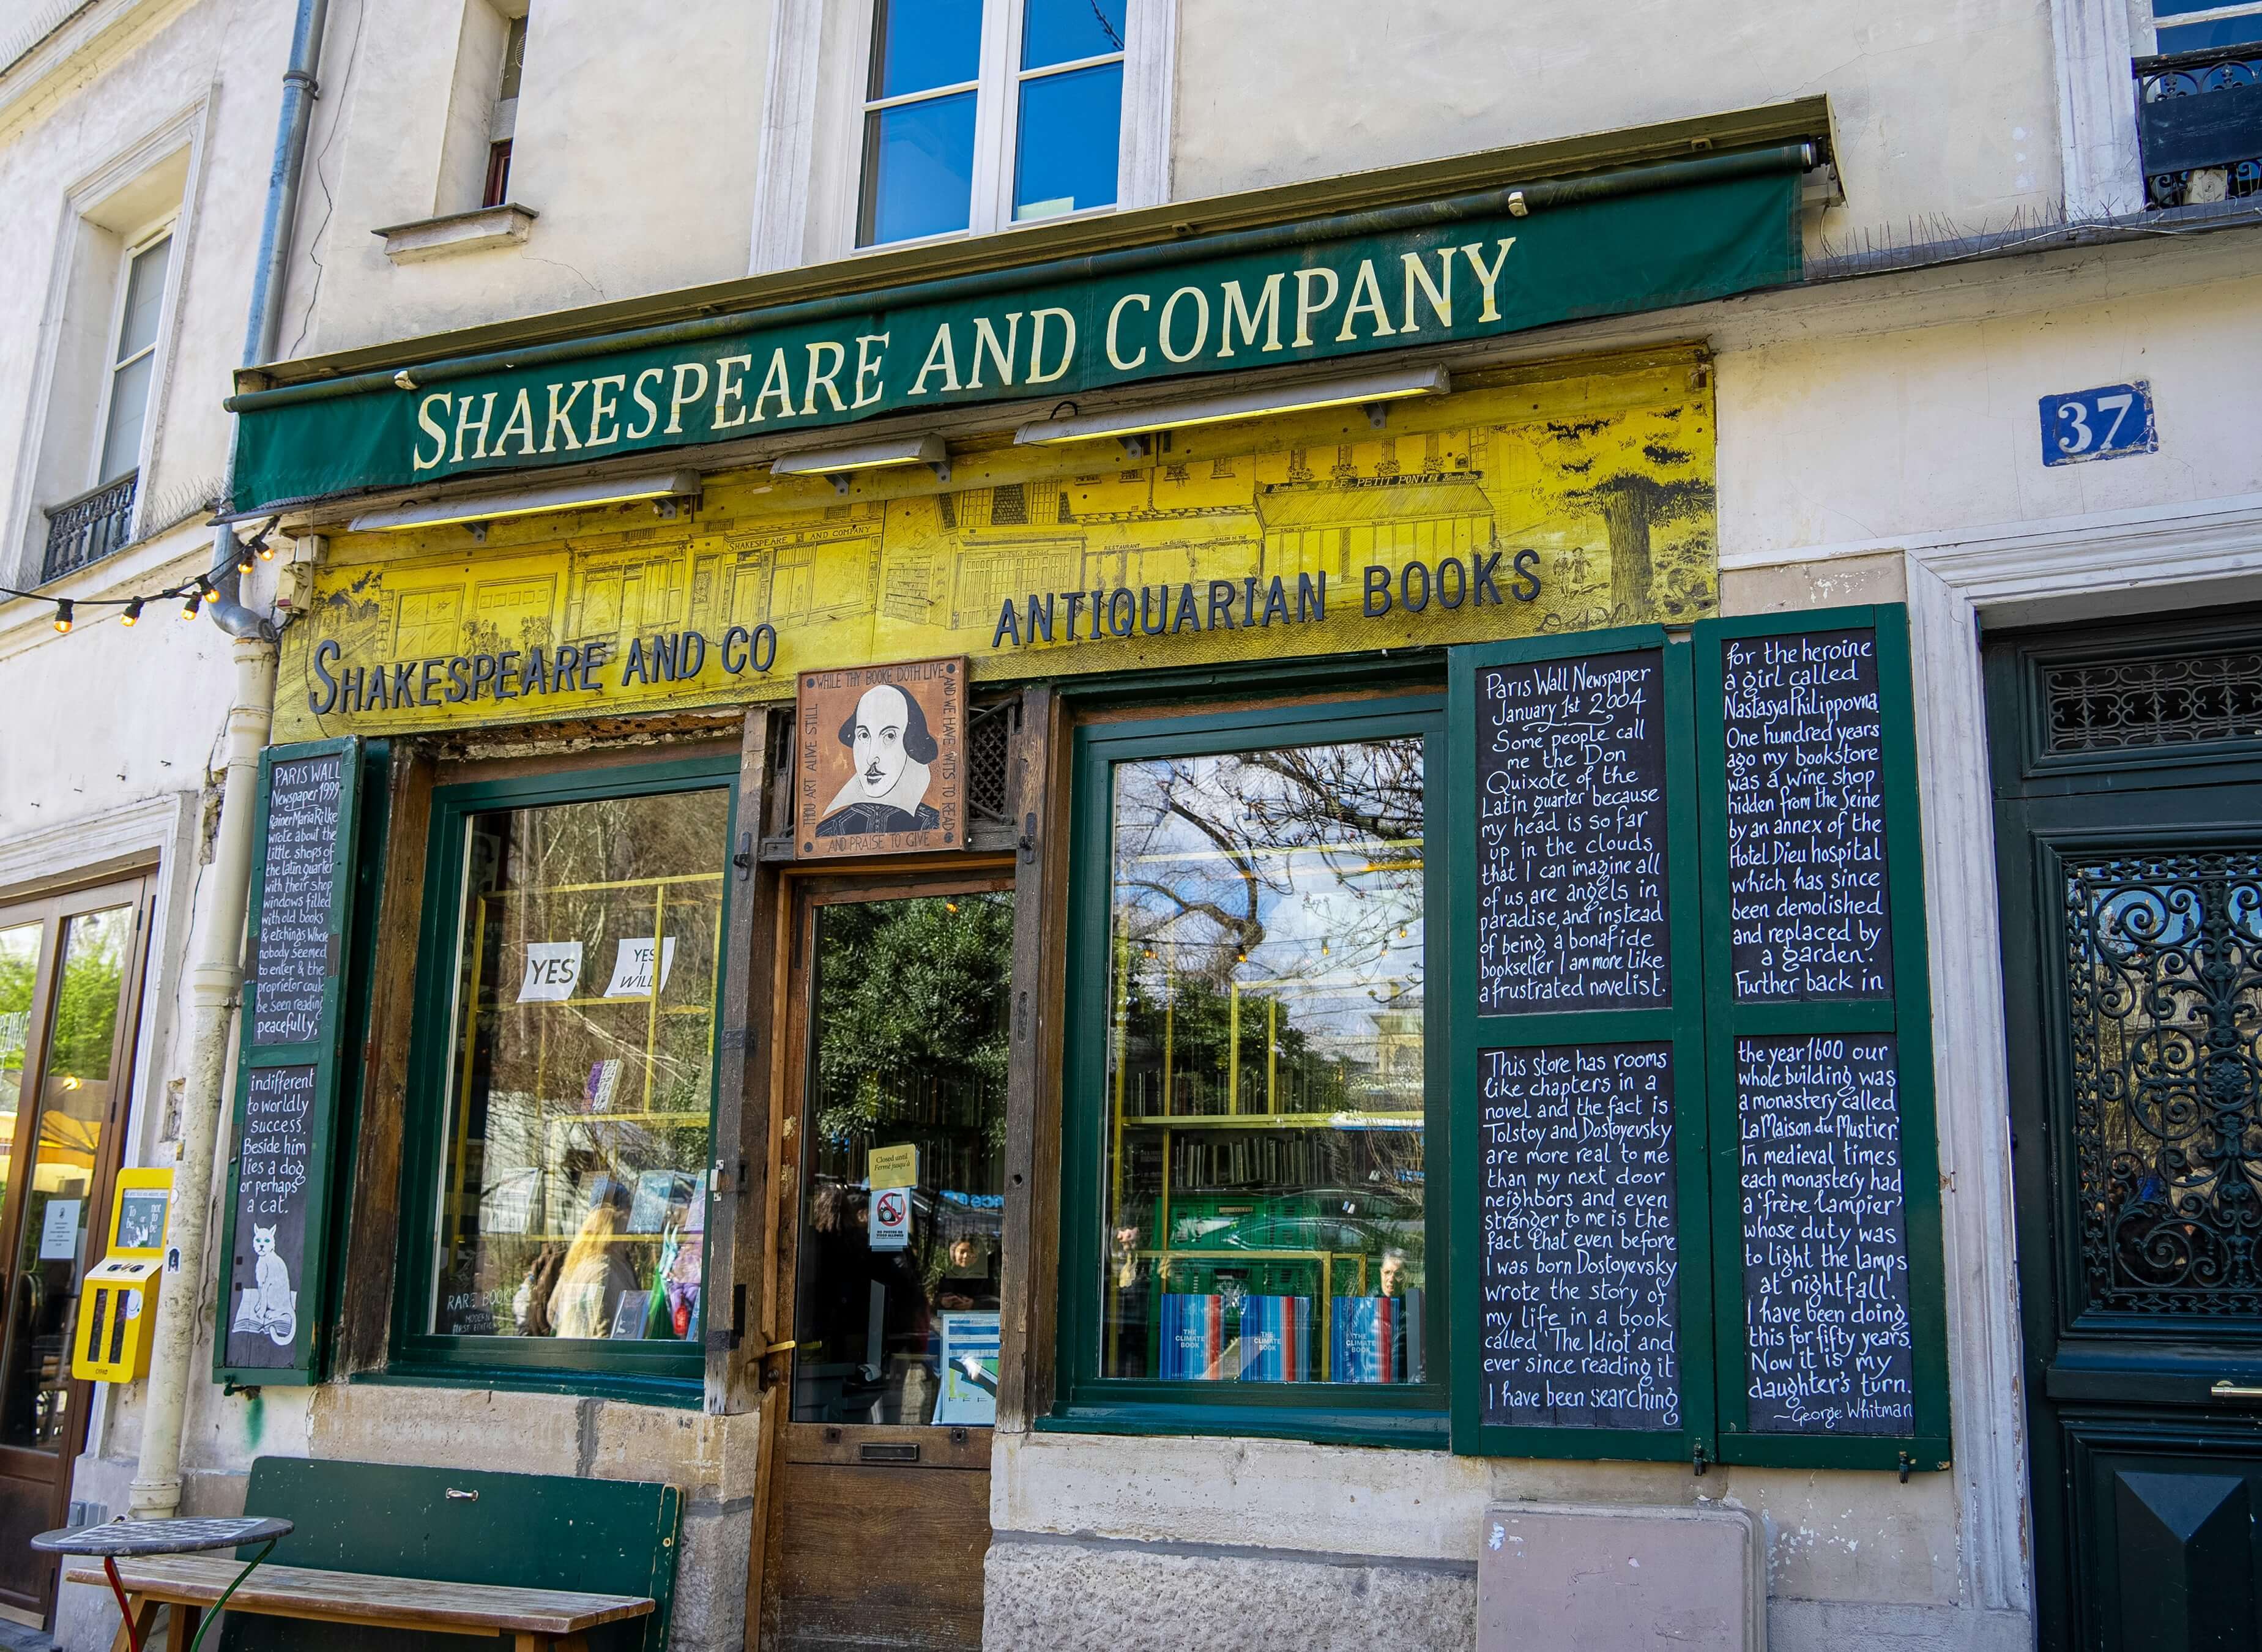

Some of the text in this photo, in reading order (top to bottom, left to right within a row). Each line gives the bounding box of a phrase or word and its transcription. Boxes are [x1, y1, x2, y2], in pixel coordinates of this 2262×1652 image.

[413, 236, 1517, 472] SHAKESPEARE AND COMPANY
[2058, 393, 2132, 453] 37
[1356, 477, 1393, 487] PETIT
[1399, 474, 1426, 485] PONT
[729, 537, 788, 551] SHAKESPEARE
[832, 526, 871, 537] COMPANY
[992, 570, 1326, 648] ANTIQUARIAN
[1363, 548, 1542, 618] BOOKS
[308, 623, 777, 716] SHAKESPEARE AND CO
[1727, 638, 1872, 671] for the heroine
[816, 663, 945, 690] WHILE THY BOOKE DOTH LIVE
[1486, 661, 1651, 700] Paris Wall Newspaper
[1725, 660, 1859, 698] a girl called
[1492, 687, 1646, 733] January 1st 2004
[1724, 691, 1788, 724] Nastasya
[1492, 718, 1645, 756] Some people call
[803, 703, 817, 828] THOU ART ALIVE STILL
[942, 677, 956, 831] AND WE HAVE WITS TO READ
[1508, 744, 1626, 770] me the Don
[275, 762, 341, 787] PARIS WALL
[1486, 765, 1639, 796] Quixote of the
[271, 782, 340, 809] Newspaper 1999
[1483, 787, 1660, 818] Latin quarter because
[269, 807, 338, 830] Rainer Maria Rilke
[828, 831, 930, 852] AND PRAISE TO GIVE
[532, 959, 575, 985] YES
[639, 962, 644, 975] I
[1479, 971, 1666, 1008] a frustrated novelist.
[1484, 1049, 1667, 1077] This store has rooms
[1738, 1037, 1889, 1068] the year 1600 our
[251, 1068, 314, 1095] indifferent
[1484, 1072, 1656, 1103] like chapters in a
[1738, 1064, 1896, 1097] whole building was
[247, 1093, 309, 1118] to worldly
[1738, 1087, 1896, 1120] a monastery called
[250, 1119, 307, 1135] success.
[1483, 1116, 1672, 1151] Tolstoy and Dostoyevsky
[242, 1135, 306, 1155] Beside him
[242, 1157, 306, 1186] lies a dog
[874, 1163, 891, 1171] Fermé
[240, 1176, 297, 1199] or perhaps
[129, 1205, 136, 1216] To
[247, 1195, 288, 1213] a cat.
[447, 1287, 514, 1311] RARE BOOKS
[1752, 1346, 1892, 1380] Now it is my
[1748, 1371, 1912, 1408] daughter's turn.
[1847, 1397, 1913, 1419] Whitman
